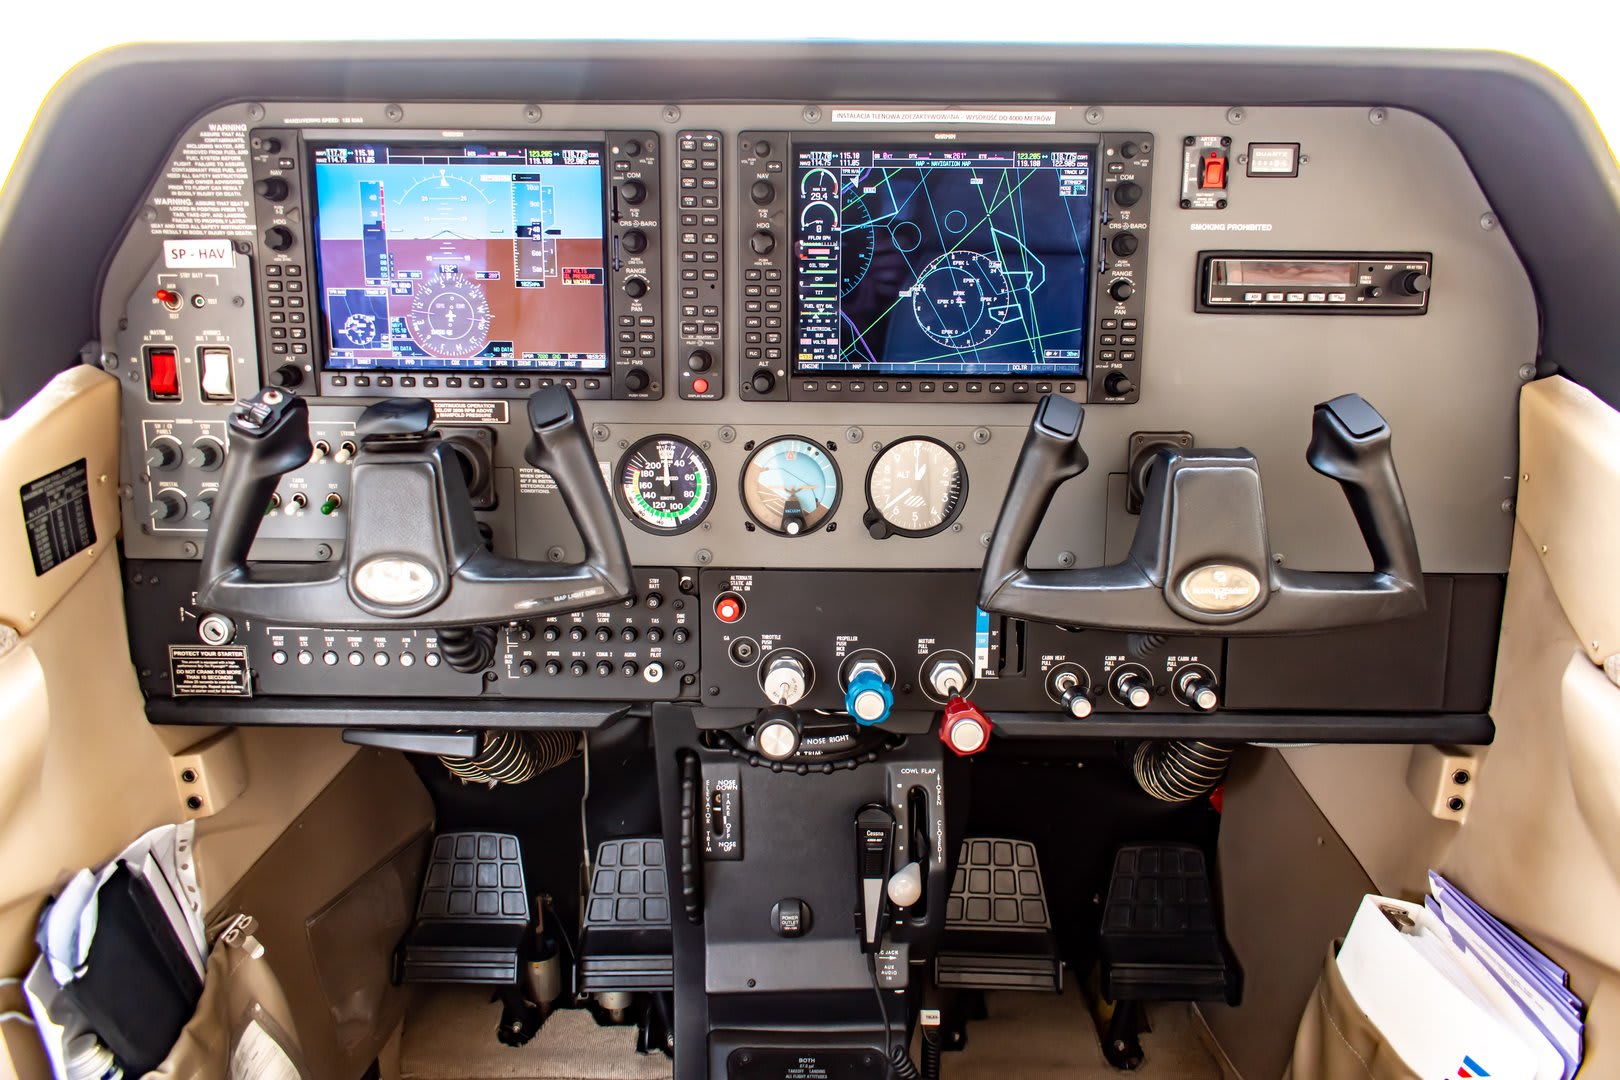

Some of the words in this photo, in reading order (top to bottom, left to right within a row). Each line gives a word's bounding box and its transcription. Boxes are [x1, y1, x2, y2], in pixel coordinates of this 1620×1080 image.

[172, 249, 186, 259] SP
[199, 249, 225, 259] HAV
[943, 468, 948, 477] 2
[942, 494, 948, 502] 3
[893, 507, 899, 515] 6
[930, 506, 938, 515] 4
[912, 512, 918, 521] 5
[829, 734, 849, 744] RIGHT
